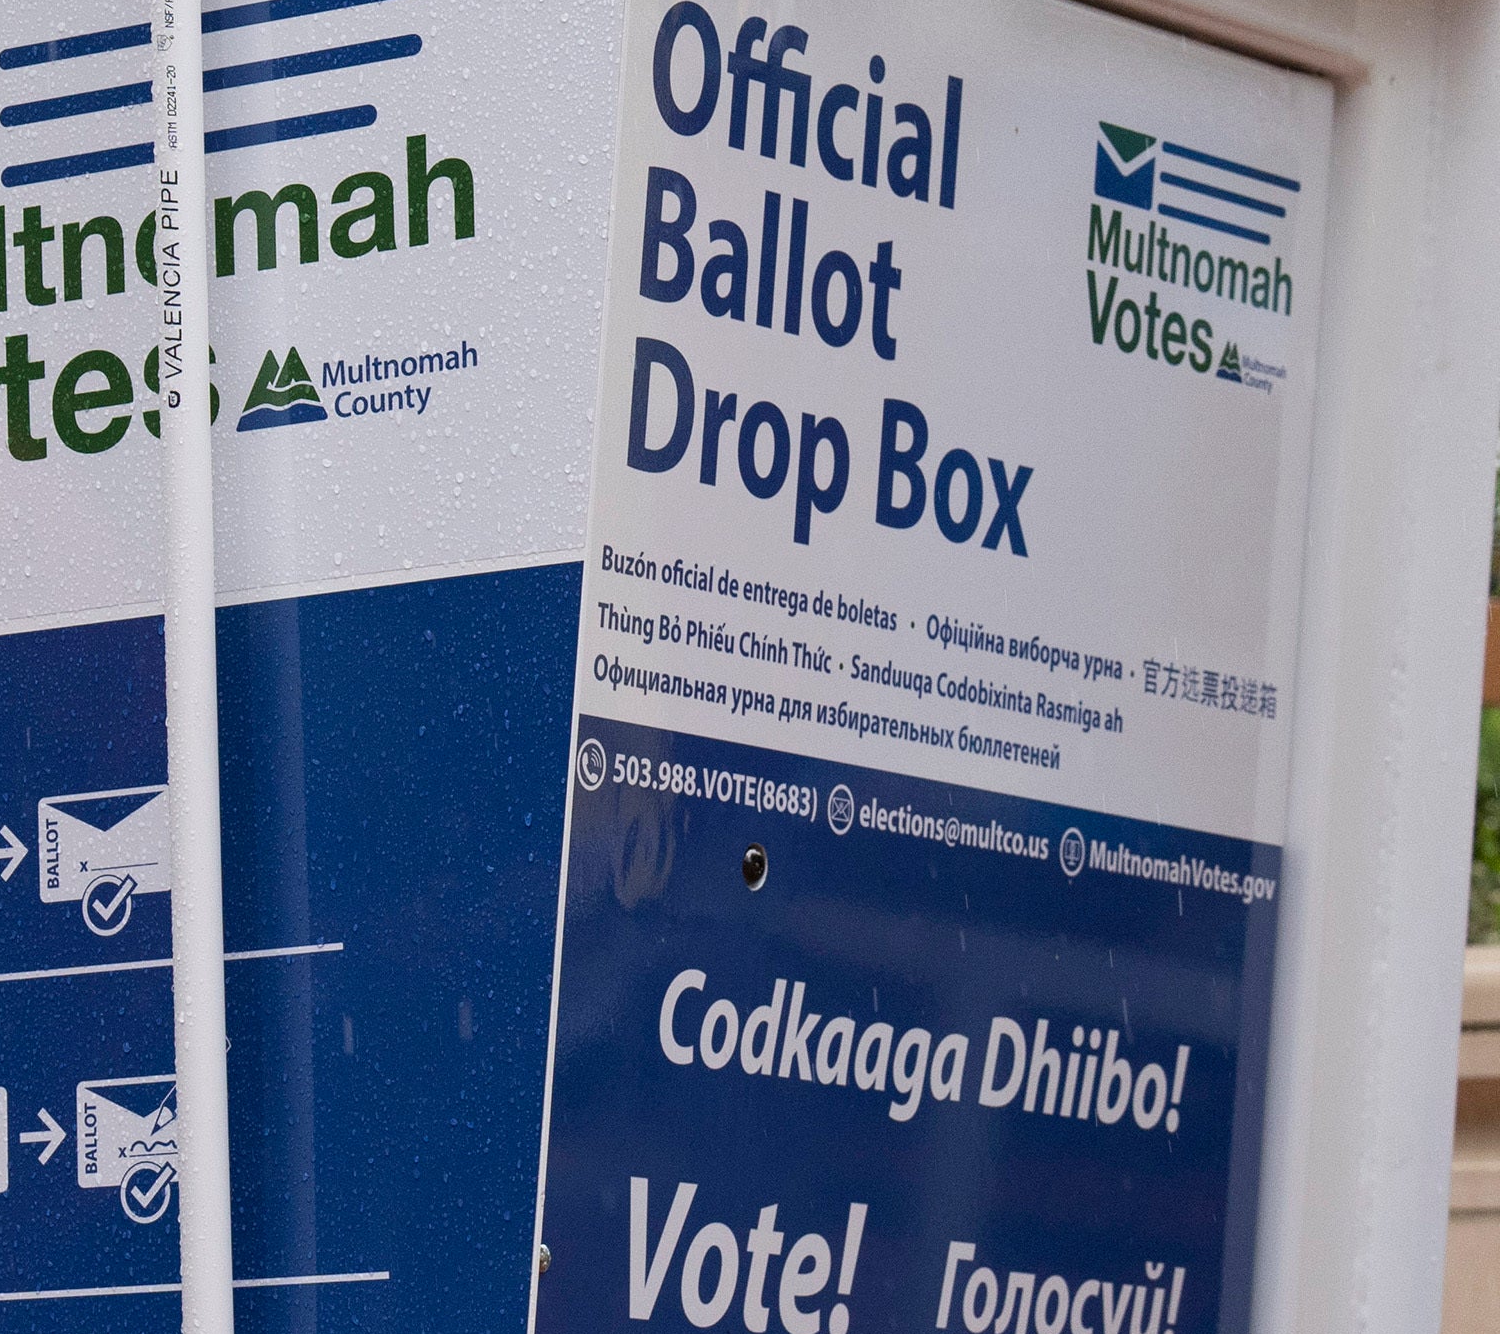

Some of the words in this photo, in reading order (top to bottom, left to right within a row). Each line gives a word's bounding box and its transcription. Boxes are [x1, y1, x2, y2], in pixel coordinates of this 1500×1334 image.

[166, 64, 177, 117] D2241-20
[652, 0, 963, 210] Official
[167, 121, 177, 149] ASTM
[160, 169, 179, 230] PIPE
[638, 166, 902, 361] Ballot
[1087, 204, 1293, 317] Multnomah
[162, 242, 183, 379] VALENCIA
[1086, 269, 1214, 373] Votes
[321, 341, 479, 388] Multnomah
[335, 384, 432, 419] County
[626, 336, 850, 546] Drop
[875, 398, 1035, 558] Box
[602, 545, 658, 583] Buzón
[661, 556, 715, 597] oficial
[717, 567, 739, 599] de
[742, 577, 808, 618] entrega
[812, 587, 833, 619] de
[837, 592, 898, 632] boletas
[597, 602, 654, 646] Thùng
[658, 614, 682, 646] Bỏ
[685, 620, 735, 655] Phiếu
[738, 629, 789, 668] Chính
[792, 636, 833, 674] Thức
[926, 614, 1005, 658] Офіційна
[1008, 633, 1080, 673] виборча
[1083, 645, 1123, 683] урна
[592, 653, 728, 708] Официальная
[732, 680, 774, 720] урна
[777, 691, 813, 725] для
[816, 697, 954, 751] избирательных
[958, 723, 1061, 772] бюллетеней
[851, 654, 933, 698] Sanduuqa
[936, 670, 1033, 718] Codobixinta
[1036, 692, 1102, 734] Rasmiga
[1104, 705, 1124, 734] ah
[46, 818, 59, 889] BALLOT
[613, 753, 818, 823] 503.988.VOTE(8683)
[859, 797, 1049, 862] elections@multco.us
[1088, 840, 1275, 903] MultnomahVotes.gov
[658, 968, 968, 1123] Codkaaga
[977, 1015, 1190, 1134] Dhiibo!
[84, 1103, 97, 1174] BALLOT
